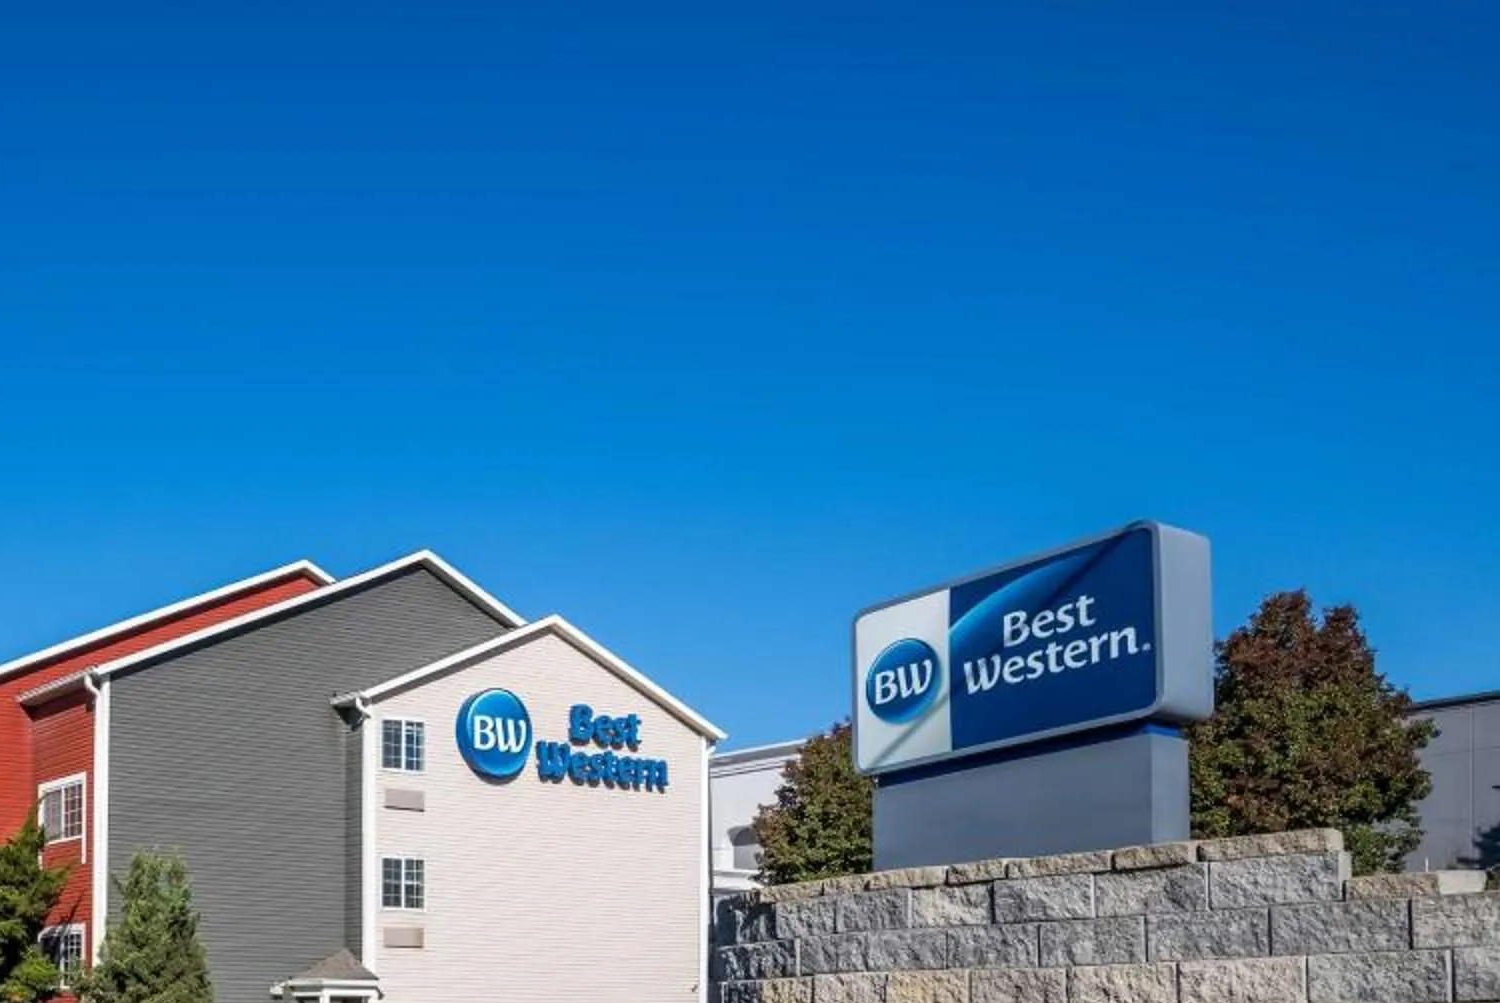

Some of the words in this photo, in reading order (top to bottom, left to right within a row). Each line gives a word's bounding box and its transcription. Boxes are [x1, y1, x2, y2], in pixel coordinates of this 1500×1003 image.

[1003, 595, 1096, 647] Best
[875, 659, 933, 705] BW
[473, 715, 527, 753] BW
[569, 704, 642, 752] Best
[535, 740, 669, 794] Western
